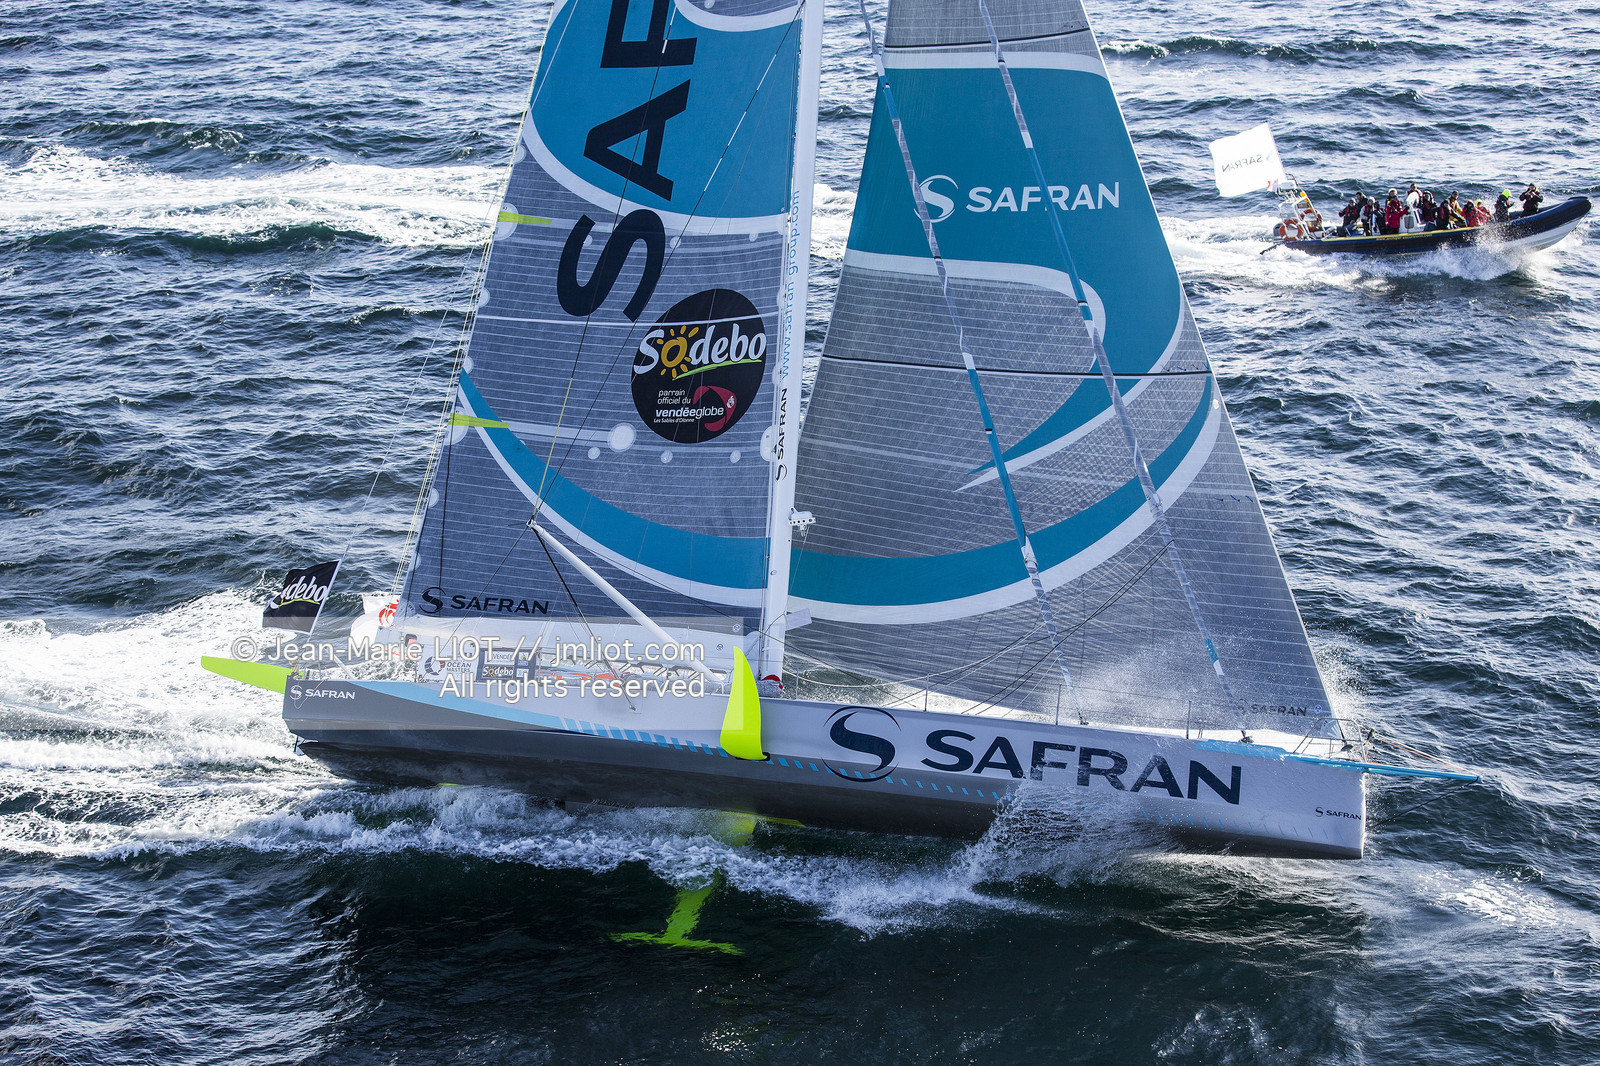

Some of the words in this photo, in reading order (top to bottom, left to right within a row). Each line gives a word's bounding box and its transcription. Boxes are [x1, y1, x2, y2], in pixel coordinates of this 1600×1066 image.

[966, 182, 1120, 213] SAFRAN
[780, 190, 801, 381] www.safran-group.com
[633, 323, 767, 375] Sodebo
[657, 397, 681, 405] officiel
[658, 389, 686, 398] parrain
[777, 388, 788, 461] SAFRAN
[264, 576, 328, 609] debo
[451, 595, 549, 615] SAFRAN
[482, 665, 514, 676] Sodebo
[305, 688, 355, 700] SAFRAN
[1250, 703, 1308, 717] SAFRAN
[921, 729, 1242, 805] SAFRAN
[1325, 809, 1362, 821] SAFRAN
